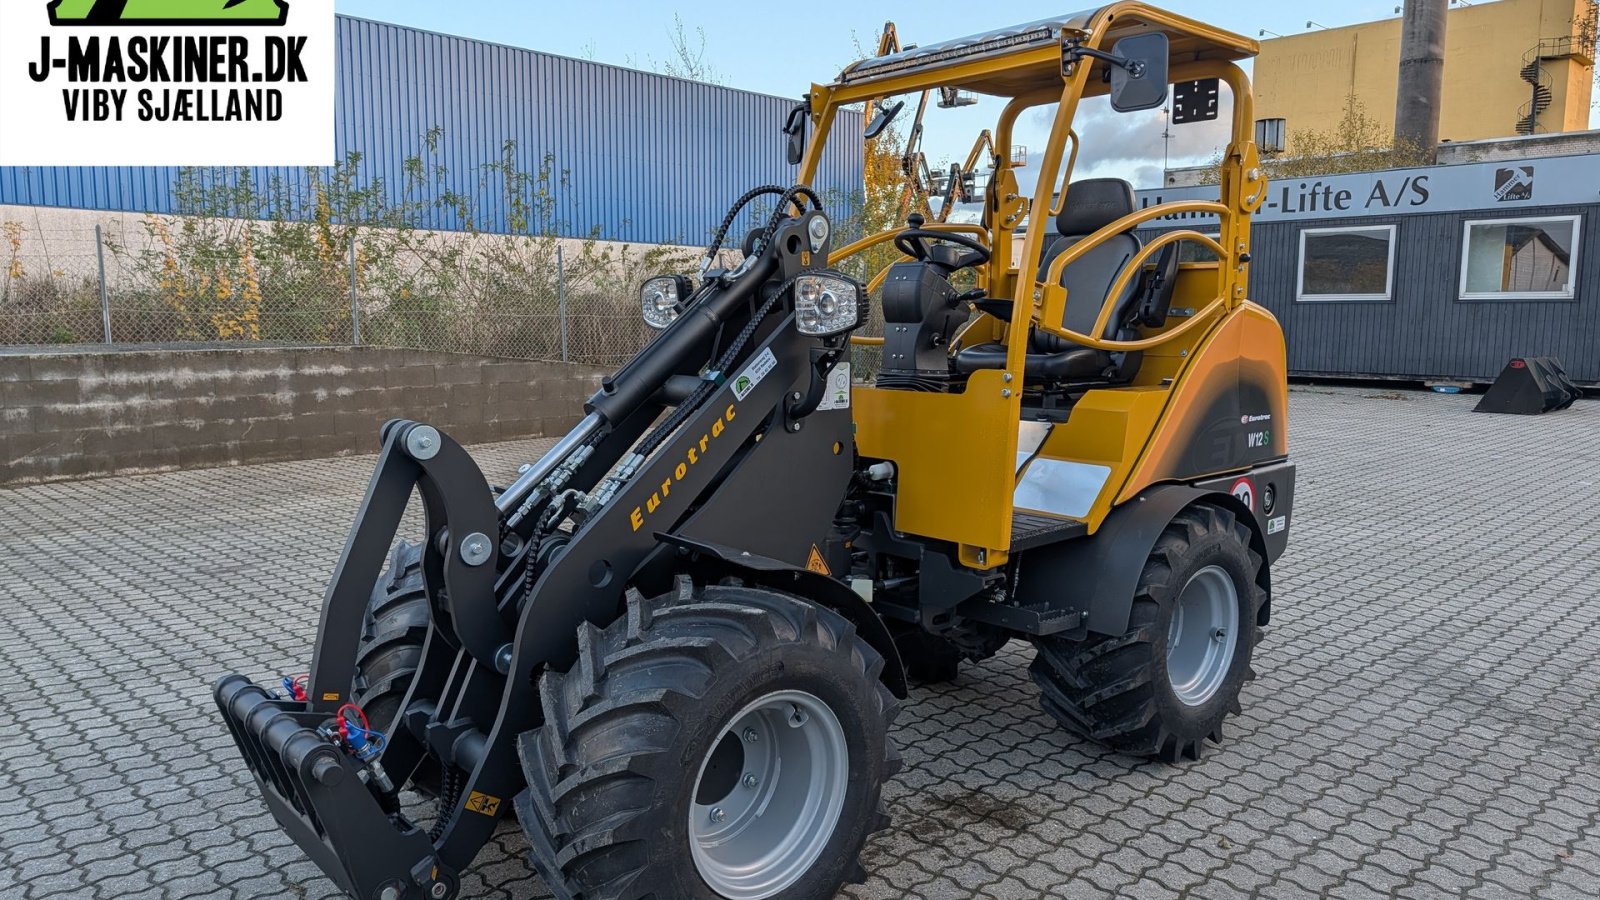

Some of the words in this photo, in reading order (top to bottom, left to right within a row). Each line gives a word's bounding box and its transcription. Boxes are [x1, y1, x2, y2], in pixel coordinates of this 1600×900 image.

[1364, 175, 1429, 208] A/S
[1493, 173, 1521, 200] Hammer
[630, 404, 736, 532] Eurotrac
